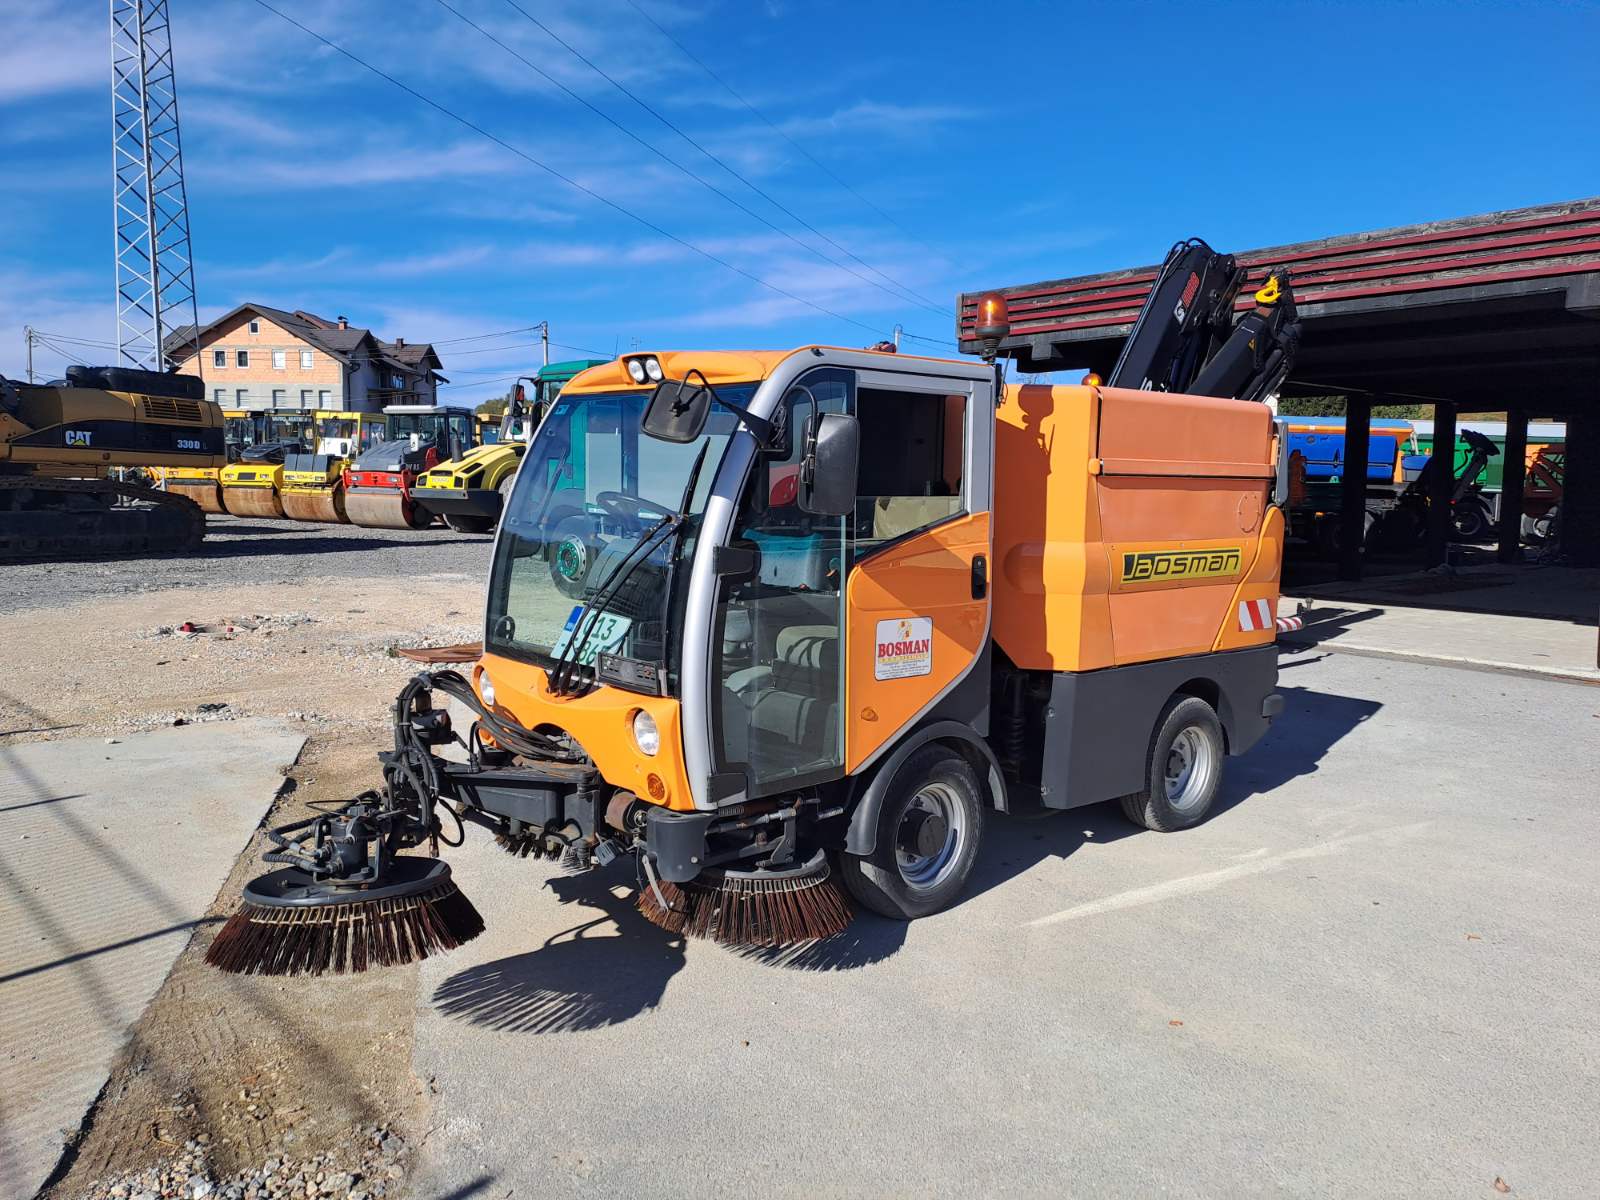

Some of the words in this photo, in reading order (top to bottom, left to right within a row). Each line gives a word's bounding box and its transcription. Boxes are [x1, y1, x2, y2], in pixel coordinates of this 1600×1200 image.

[65, 430, 92, 446] CAT
[176, 439, 200, 449] 330D
[877, 639, 931, 658] BOSMAN
